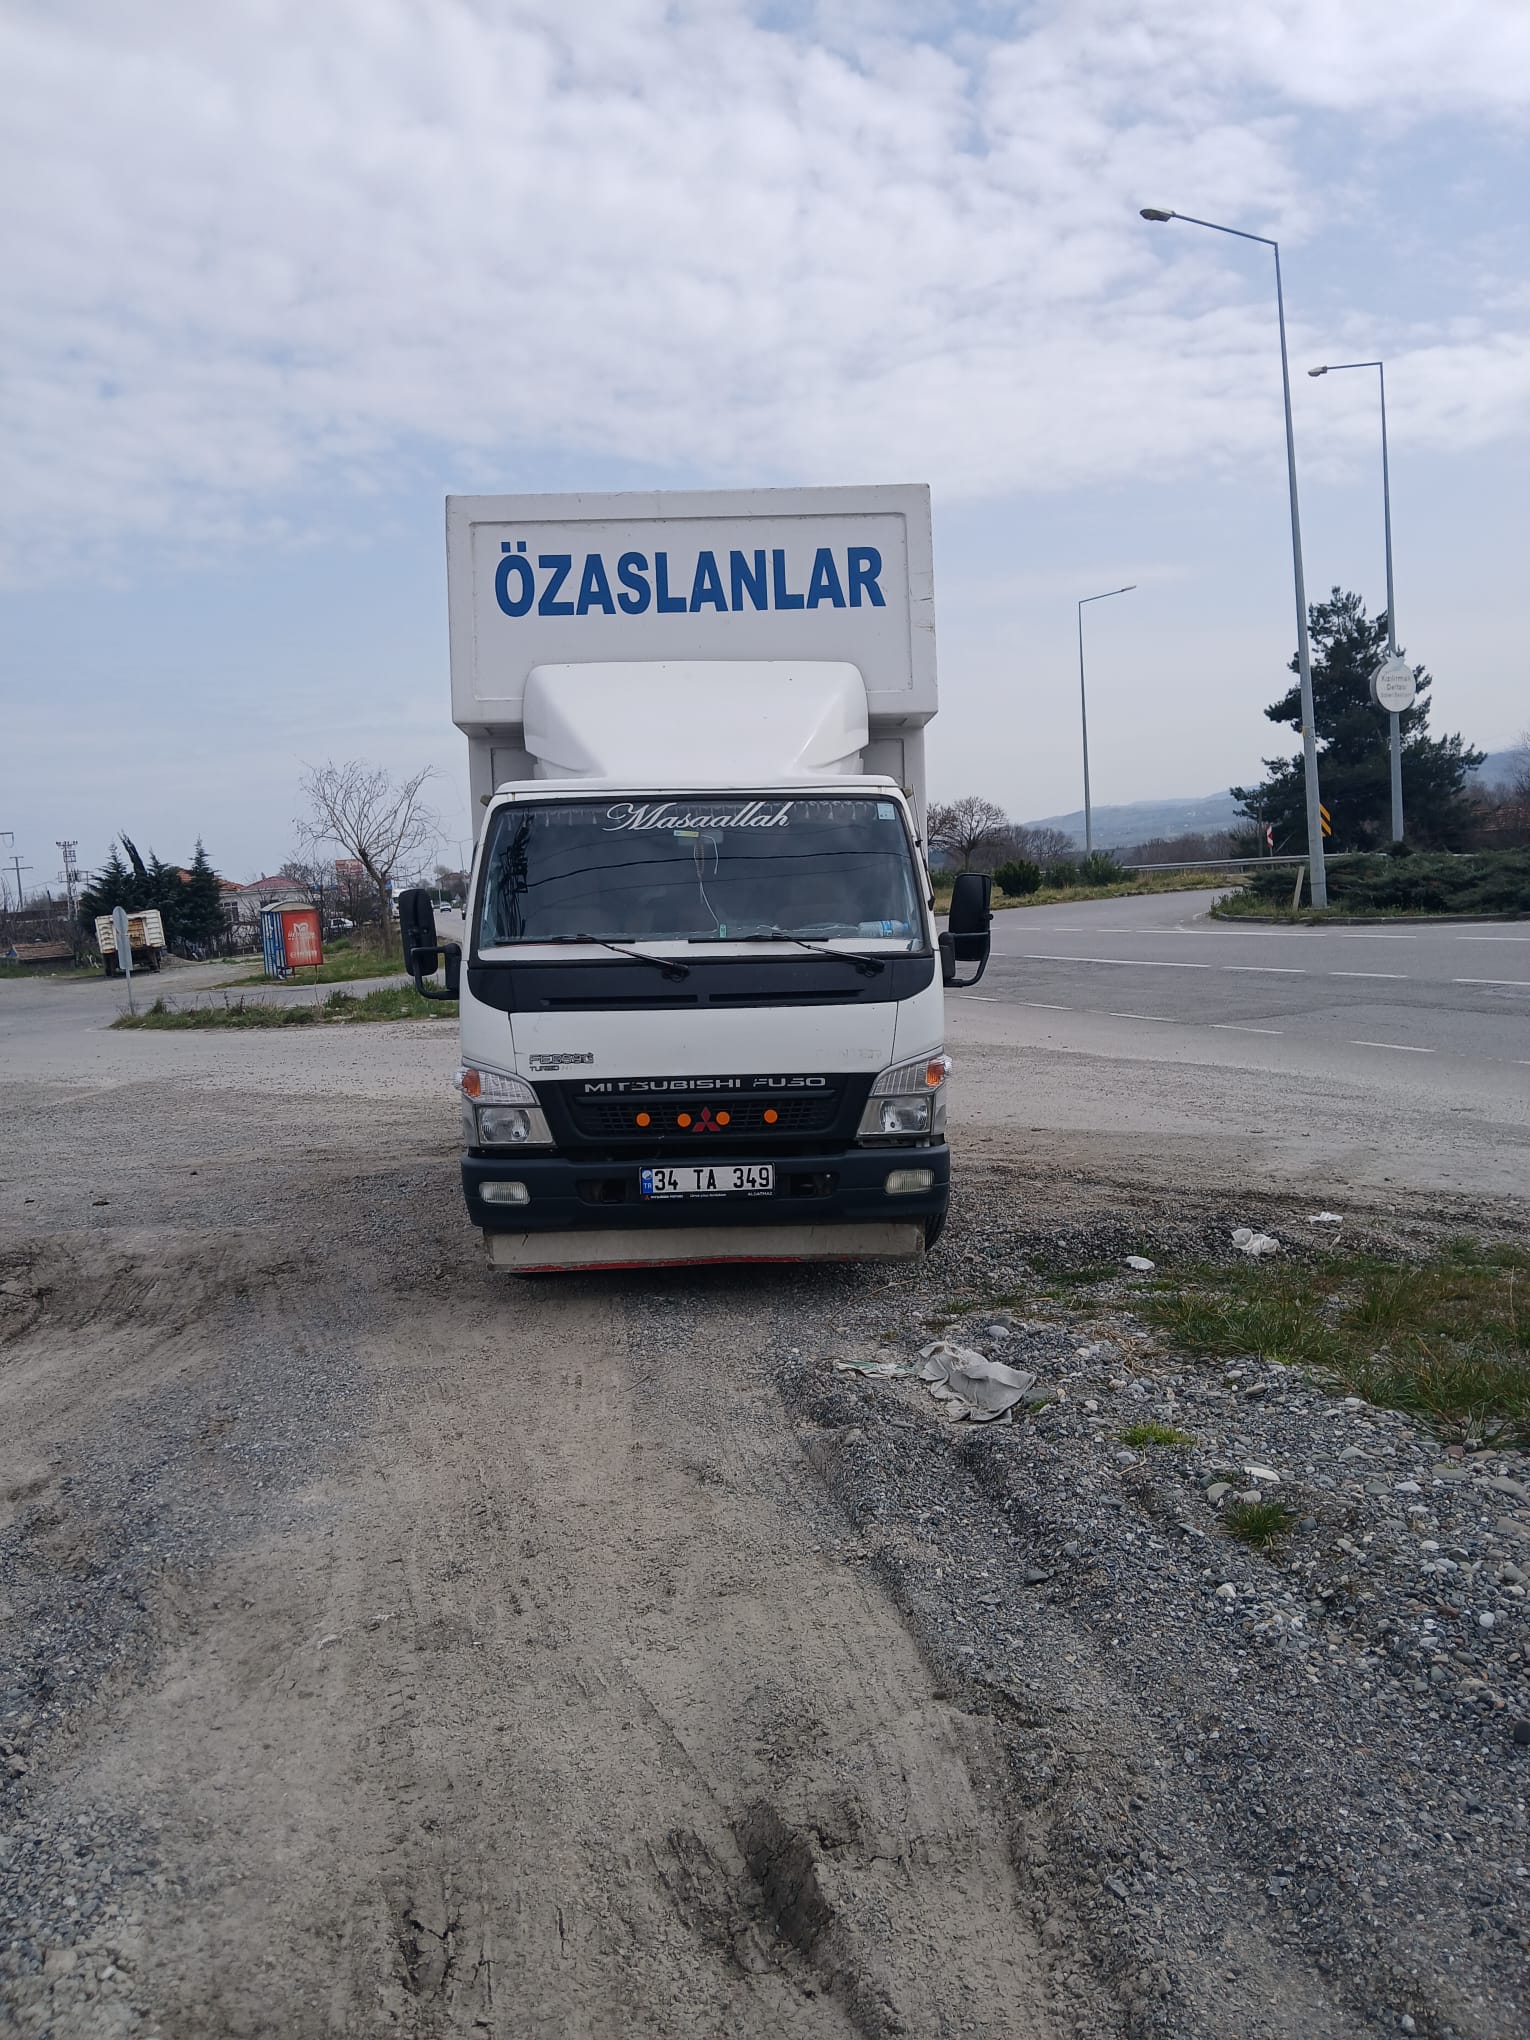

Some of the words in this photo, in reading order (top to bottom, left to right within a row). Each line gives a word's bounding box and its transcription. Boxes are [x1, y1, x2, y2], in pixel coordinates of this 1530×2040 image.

[495, 541, 886, 617] ÖZASLANLAR
[584, 1079, 741, 1093] MITSUBISHI
[753, 1077, 826, 1088] FUSO
[654, 1170, 679, 1191] 34
[693, 1168, 717, 1190] TA
[733, 1167, 770, 1189] 349
